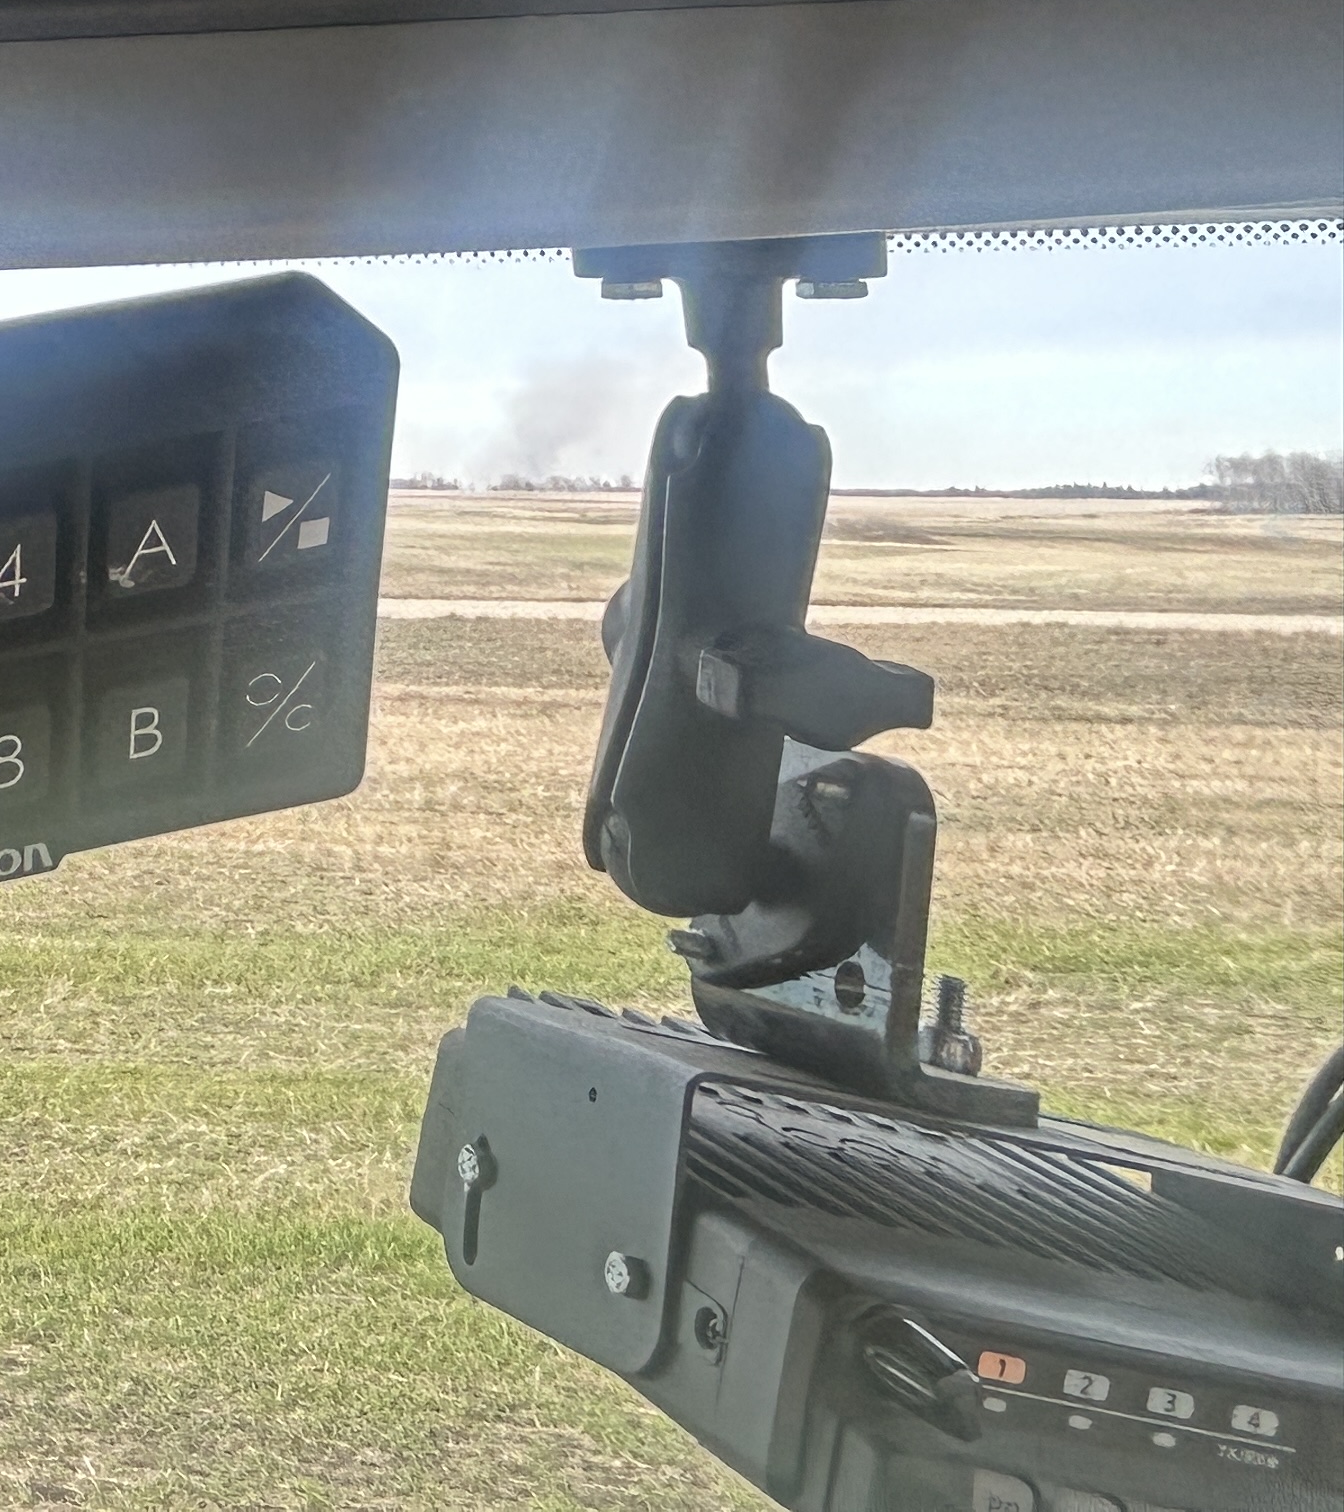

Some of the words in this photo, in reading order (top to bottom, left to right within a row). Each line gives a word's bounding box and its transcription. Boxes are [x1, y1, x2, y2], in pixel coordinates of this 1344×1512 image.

[127, 519, 179, 571] A
[130, 707, 164, 760] B
[998, 1358, 1007, 1378] 1
[1079, 1375, 1093, 1396] 2
[1163, 1392, 1177, 1412] 3
[1247, 1410, 1261, 1429] 4
